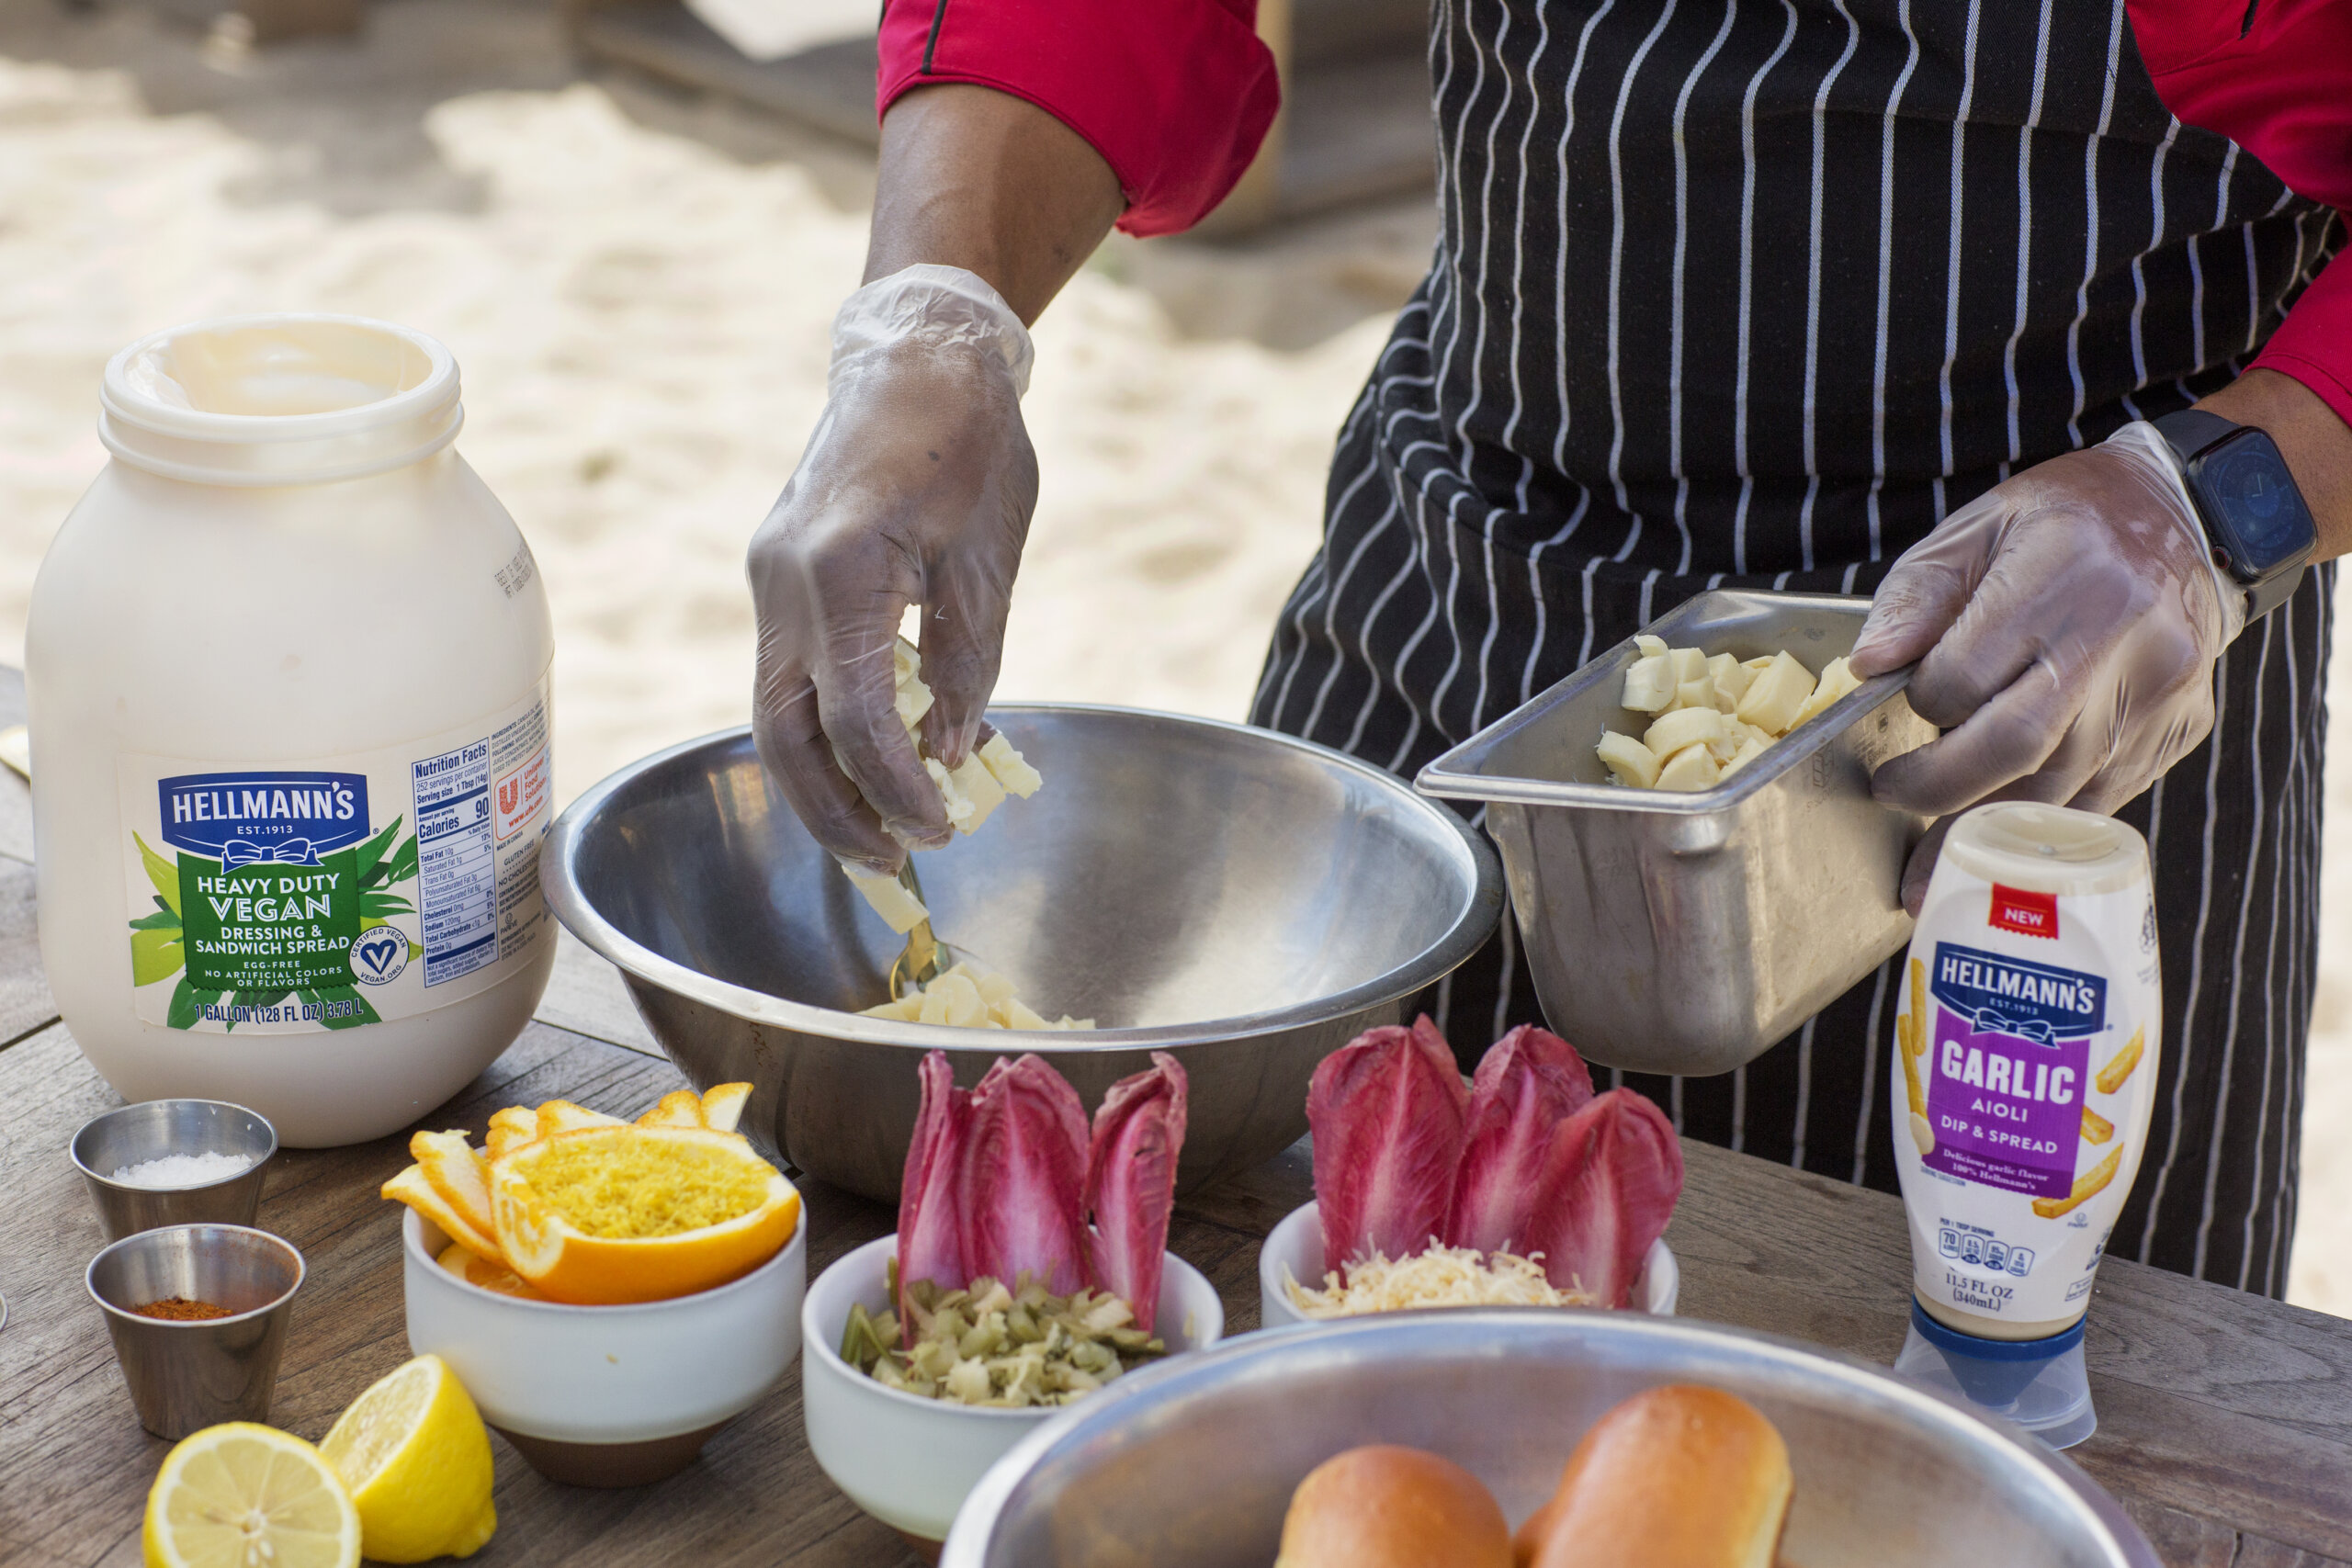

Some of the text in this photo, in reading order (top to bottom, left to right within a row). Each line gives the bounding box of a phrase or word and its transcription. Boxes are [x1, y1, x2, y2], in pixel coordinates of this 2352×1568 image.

[415, 755, 459, 779] Nutrition
[462, 743, 487, 764] Facts
[416, 761, 487, 793] 252 servings per container
[525, 772, 538, 791] Food
[417, 772, 488, 804] Serving size 1 Tbsp (14g)
[173, 781, 355, 824] HELLMANN'S
[419, 797, 489, 839] Calories 90
[237, 825, 293, 835] EST.1913
[421, 847, 454, 863] Total Fat 10g
[503, 839, 534, 865] GLUTEN FREE
[424, 856, 462, 874] Saturated Fat 1g
[198, 873, 340, 895] HEAVY DUTY
[424, 871, 454, 886] Trans Fat 0g
[425, 877, 463, 898] Polyunsaturated
[498, 877, 507, 887] NO
[208, 894, 332, 922] VEGAN
[426, 889, 467, 908] Monounsaturated
[424, 903, 464, 921] Cholesterol 0mg
[2005, 907, 2043, 927] NEW
[220, 925, 322, 941] DRESSING &
[424, 916, 461, 932] Sodium 120mg
[425, 934, 439, 944] Total
[439, 923, 471, 941] Carbohydrate
[196, 936, 350, 955] SANDWICH SPREAD
[351, 928, 406, 957] CERTIFIED VEGAN
[426, 942, 452, 956] Protein 0g
[205, 966, 343, 980] NO ARTIFICIAL COLORS
[243, 960, 301, 969] EGG-FREE
[360, 964, 401, 983] VEGAN.ORG
[237, 977, 311, 987] OR FLAVORS
[1940, 955, 2096, 1015] HELLMANN'S
[195, 1000, 363, 1025] 1 GALLON (128 FL OZ) 3.78 L
[1940, 1039, 2075, 1105] GARLIC
[1971, 1098, 2028, 1122] AIOLI
[1940, 1115, 2058, 1155] DIP & SPREAD
[1943, 1148, 2050, 1183] Delicious garlic flavor
[1951, 1162, 1976, 1179] 100%
[1979, 1170, 2036, 1190] Hellmann's
[1944, 1232, 1956, 1245] 70
[1946, 1273, 2013, 1299] 11.5 FL OZ
[1952, 1287, 2001, 1312] (340mL)
